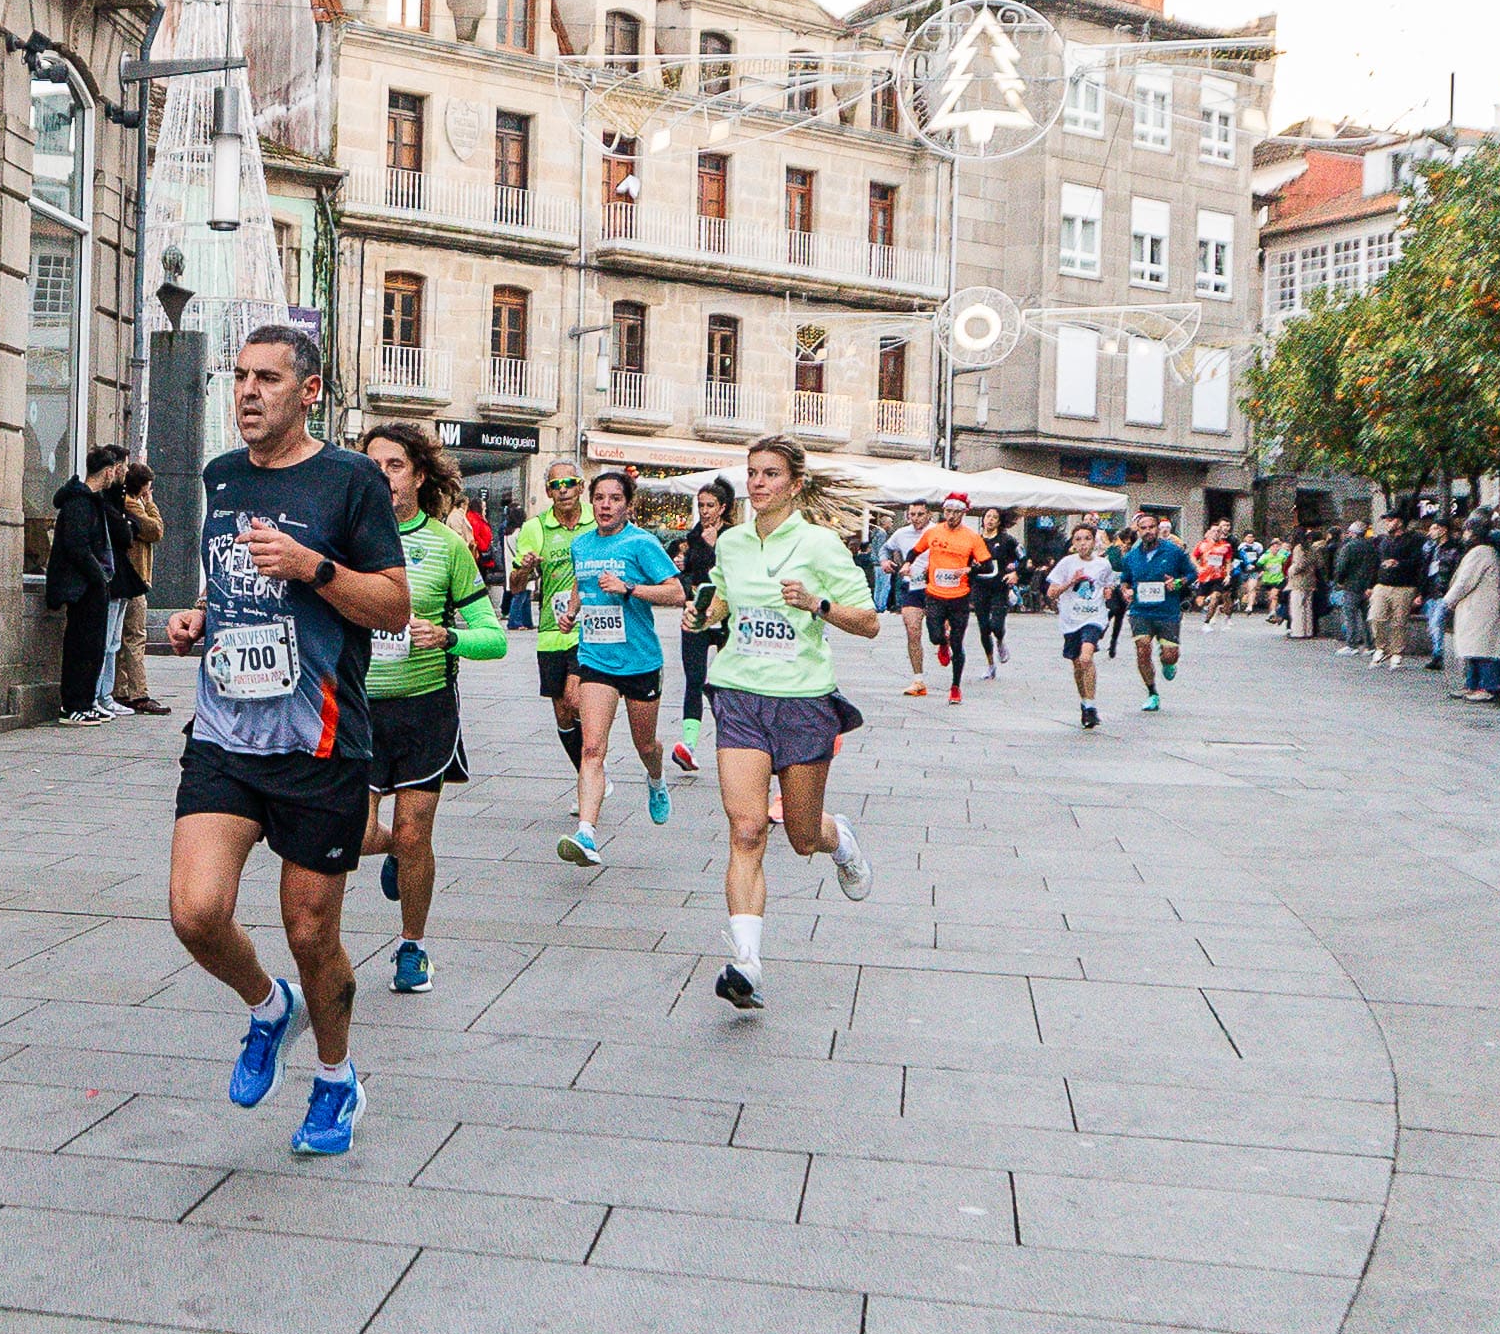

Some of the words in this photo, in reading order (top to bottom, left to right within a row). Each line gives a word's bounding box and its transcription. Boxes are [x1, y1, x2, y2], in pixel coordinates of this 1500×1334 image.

[503, 434, 536, 449] Nogueira
[208, 533, 234, 551] 2025
[594, 616, 622, 629] 2505
[754, 621, 796, 641] 5633
[237, 628, 280, 646] SILVESTRE
[236, 645, 277, 672] 700
